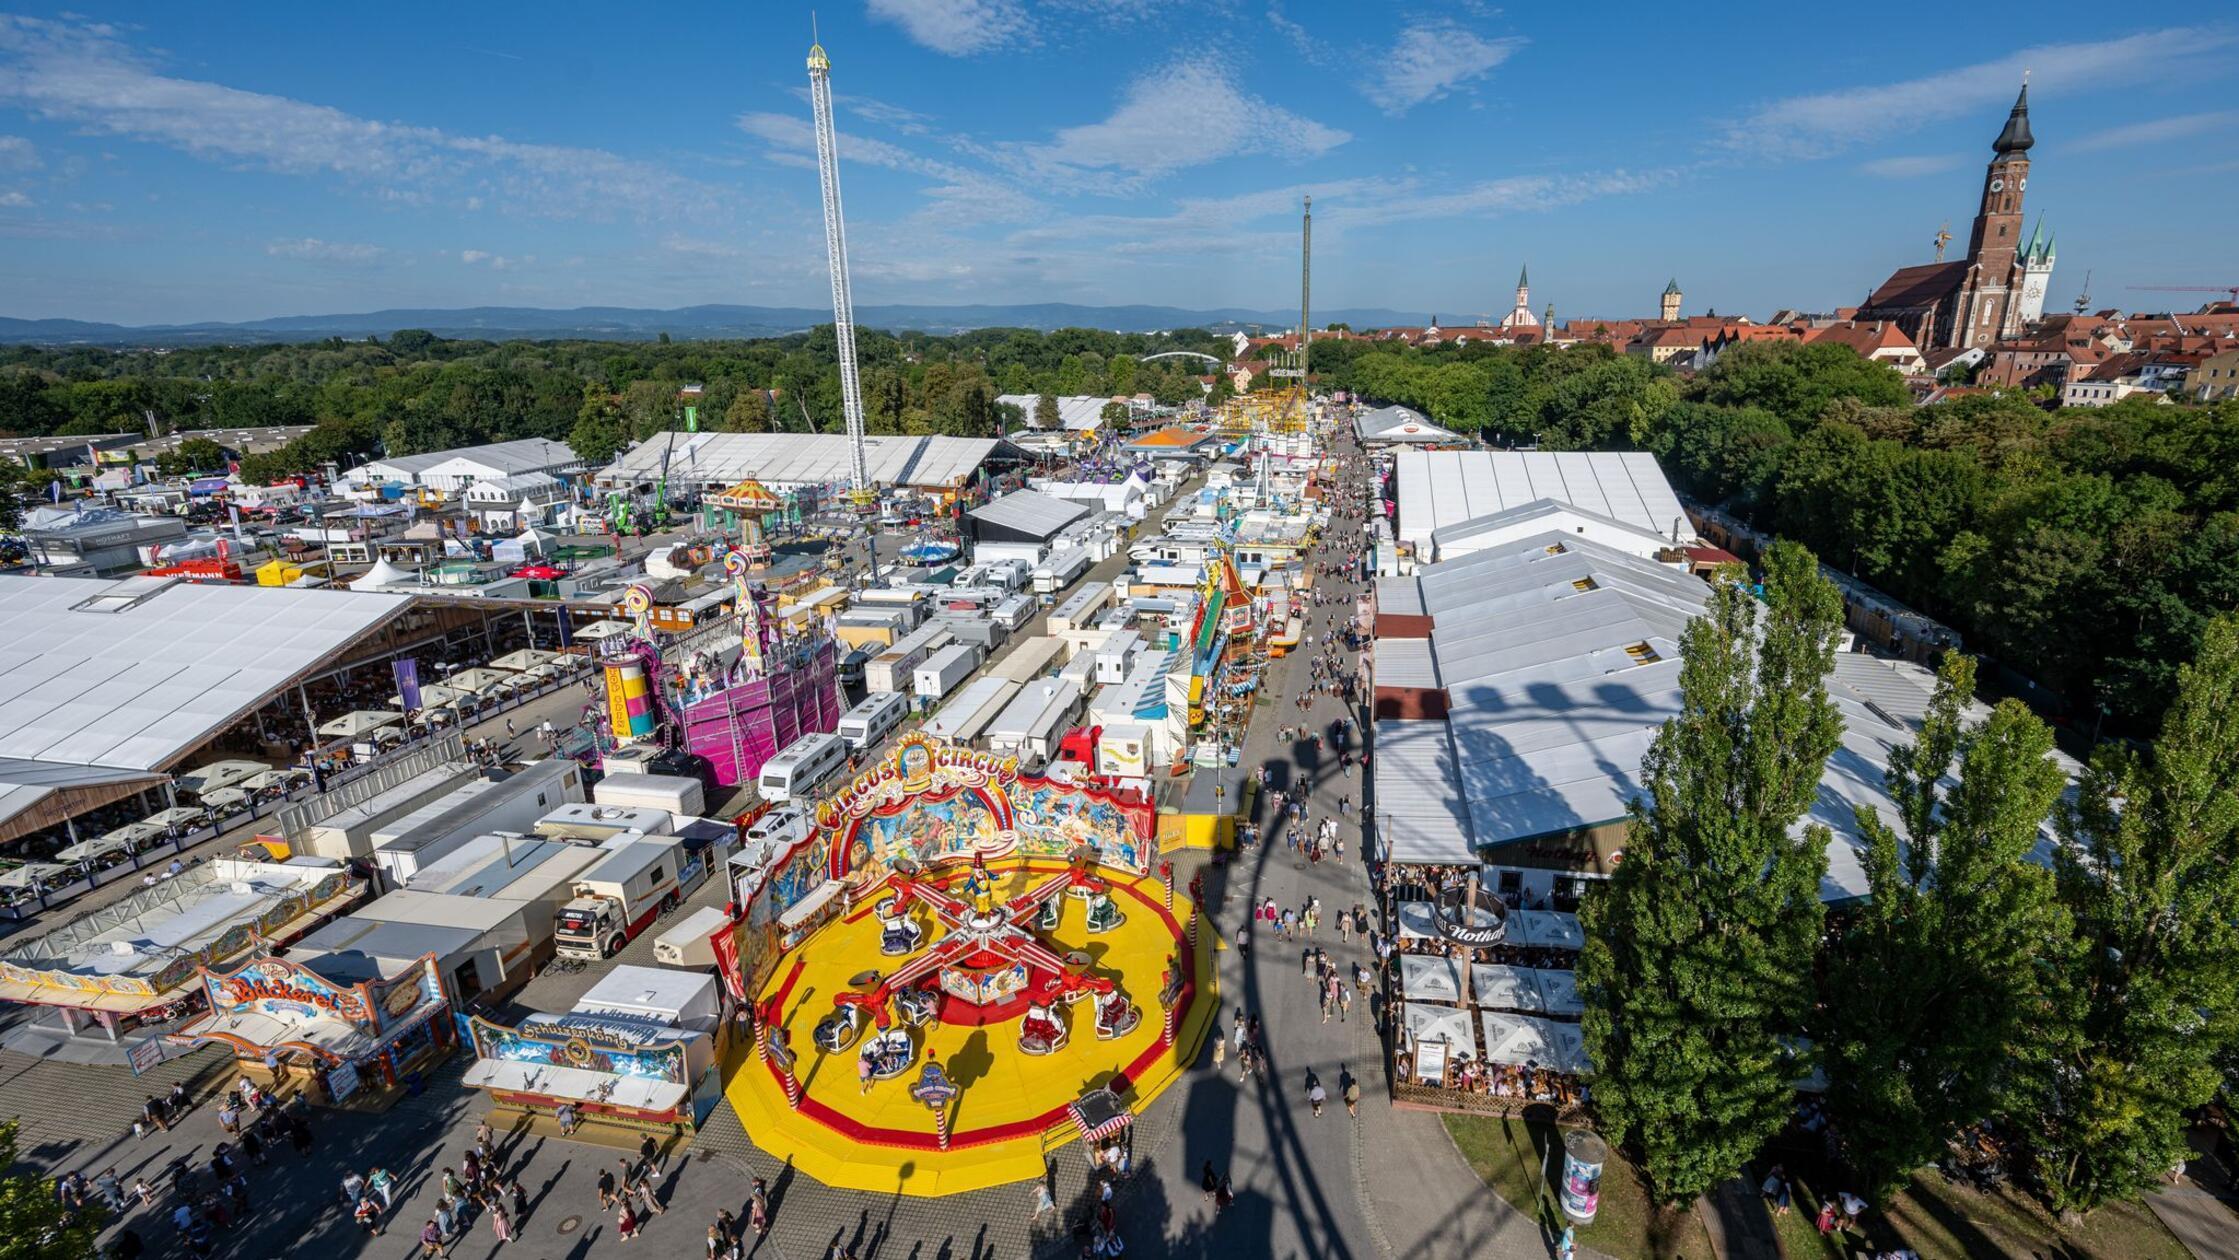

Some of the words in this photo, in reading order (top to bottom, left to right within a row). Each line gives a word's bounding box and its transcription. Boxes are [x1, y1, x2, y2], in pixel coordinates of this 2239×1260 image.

[815, 760, 896, 831] CIRCUS
[936, 748, 1018, 788] CIRCUS
[230, 977, 339, 1011] Bäckerei
[524, 1023, 628, 1050] Schützenkönig
